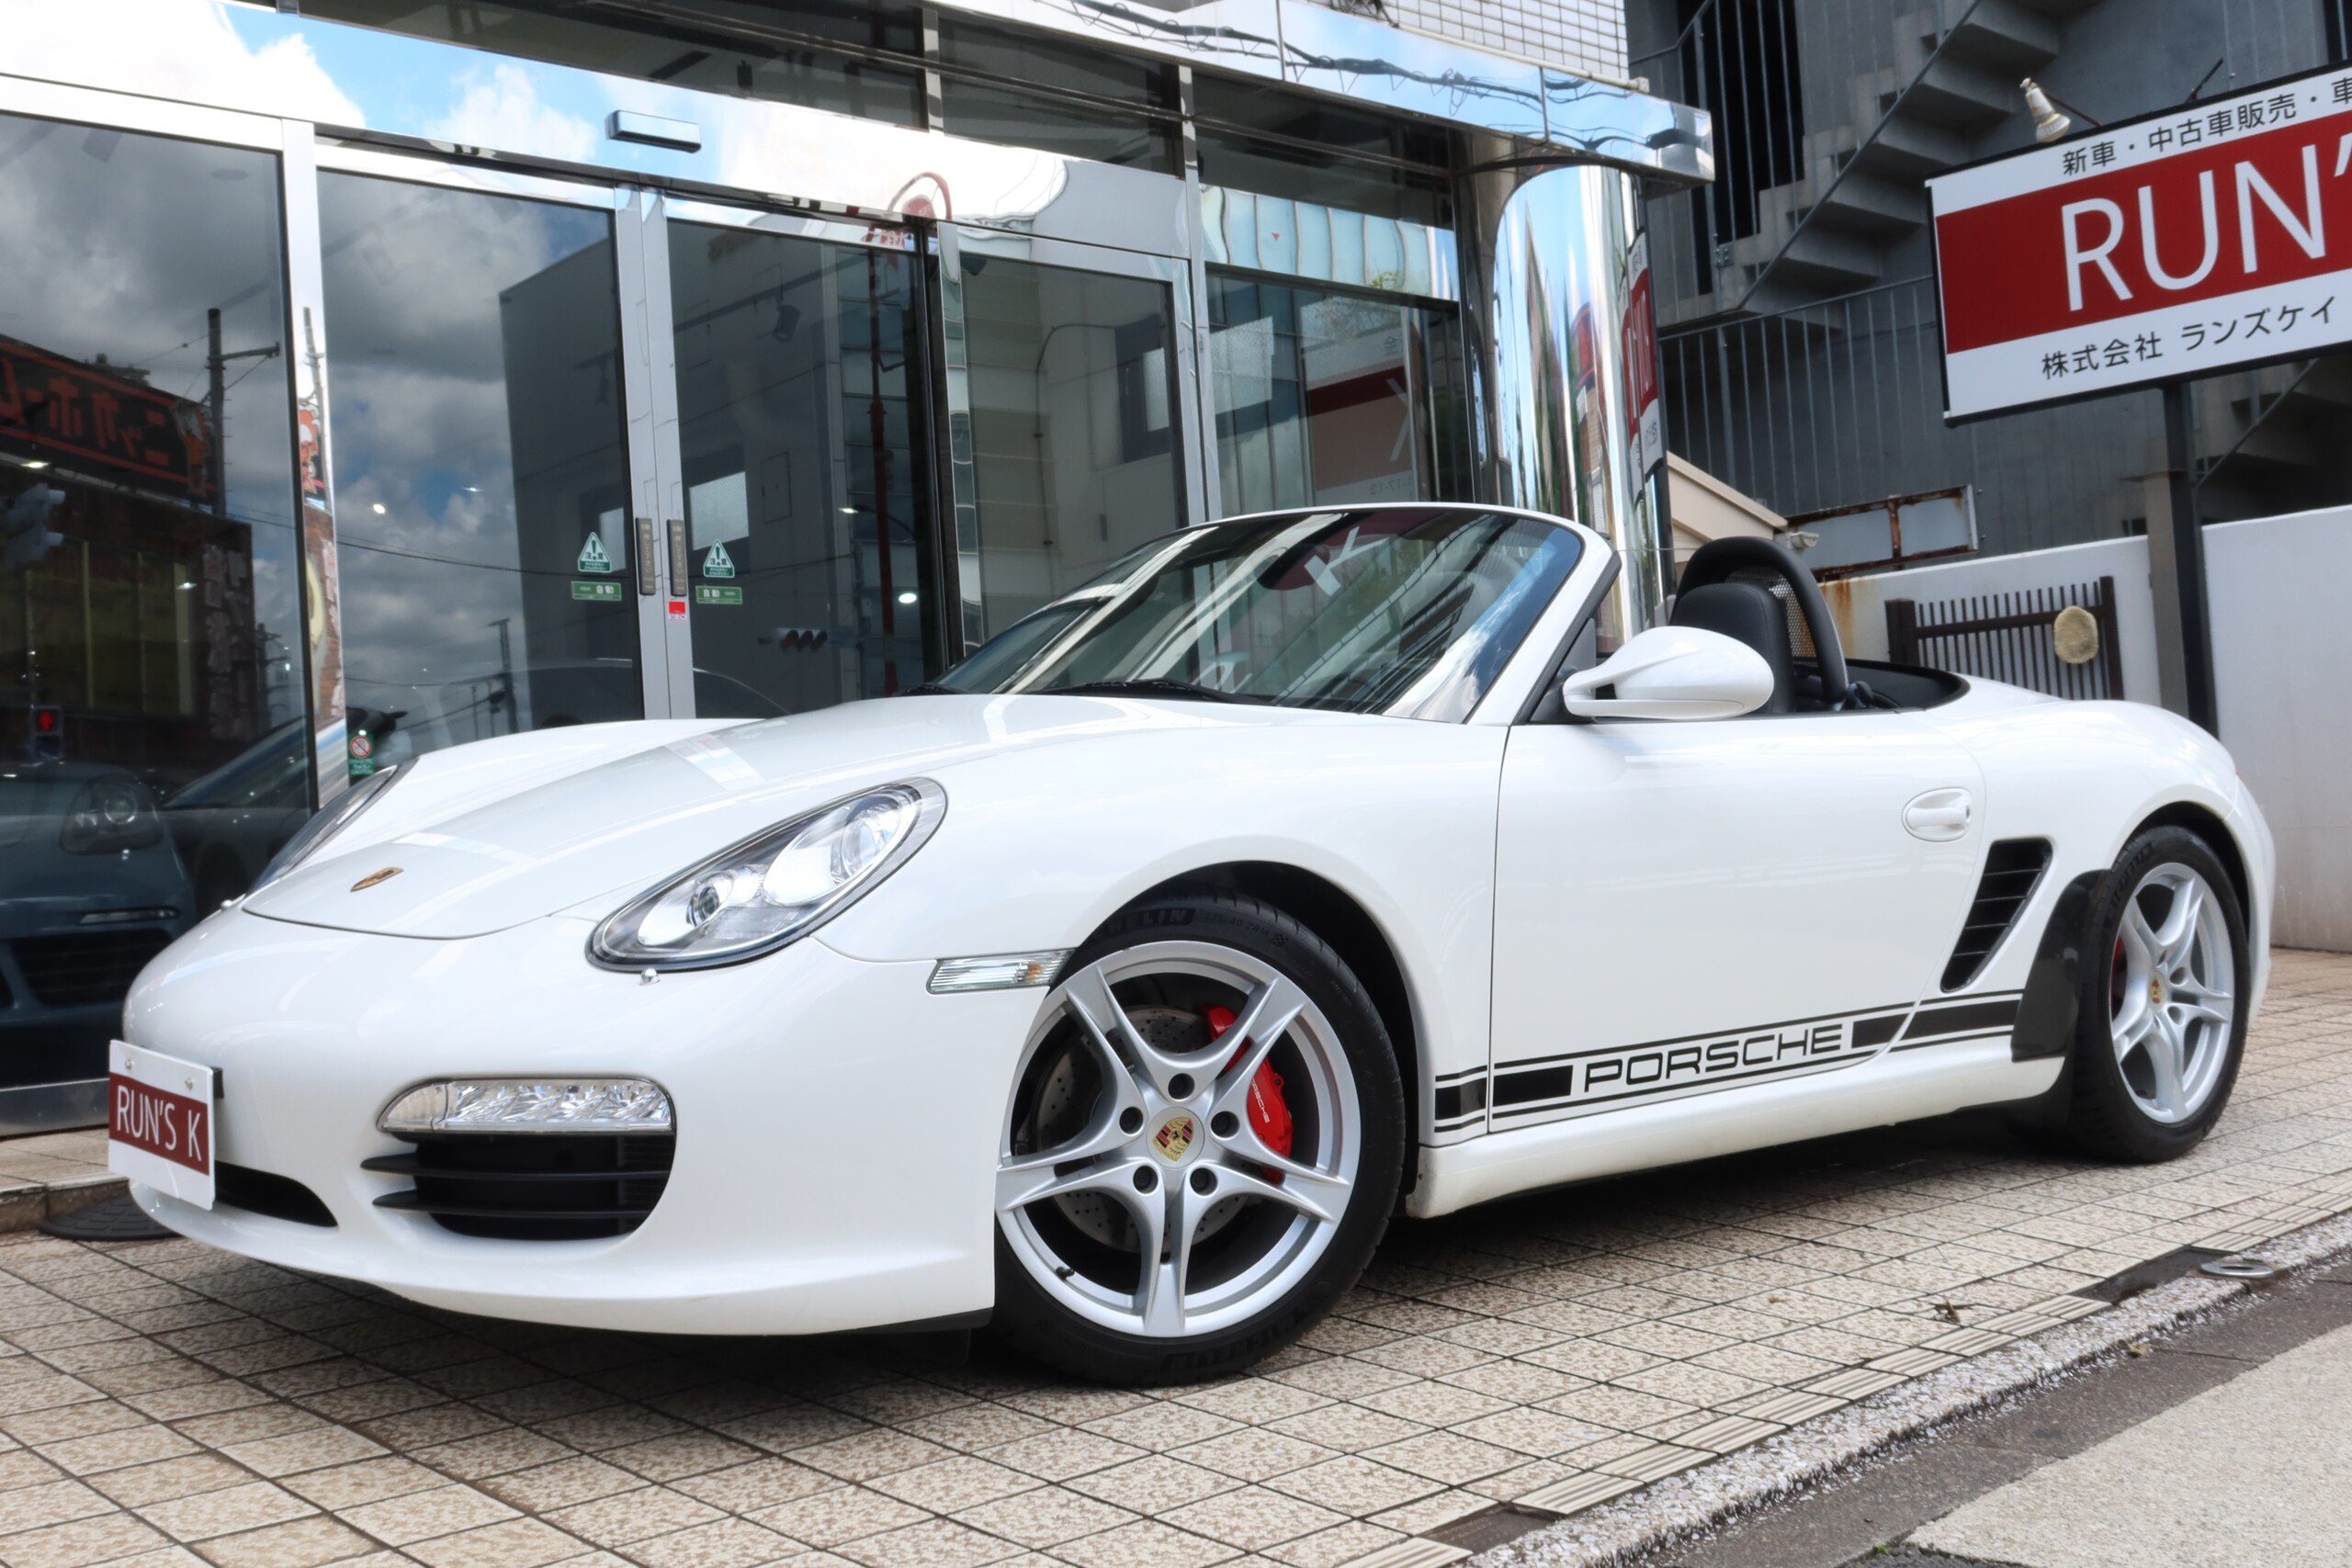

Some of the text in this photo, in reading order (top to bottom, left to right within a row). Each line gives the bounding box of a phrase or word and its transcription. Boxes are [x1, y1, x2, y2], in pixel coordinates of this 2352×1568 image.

[2041, 296, 2336, 380] 株式会社 ランズケイ
[1583, 1022, 1843, 1093] PORSCHE
[117, 1084, 202, 1162] RUN'S K
